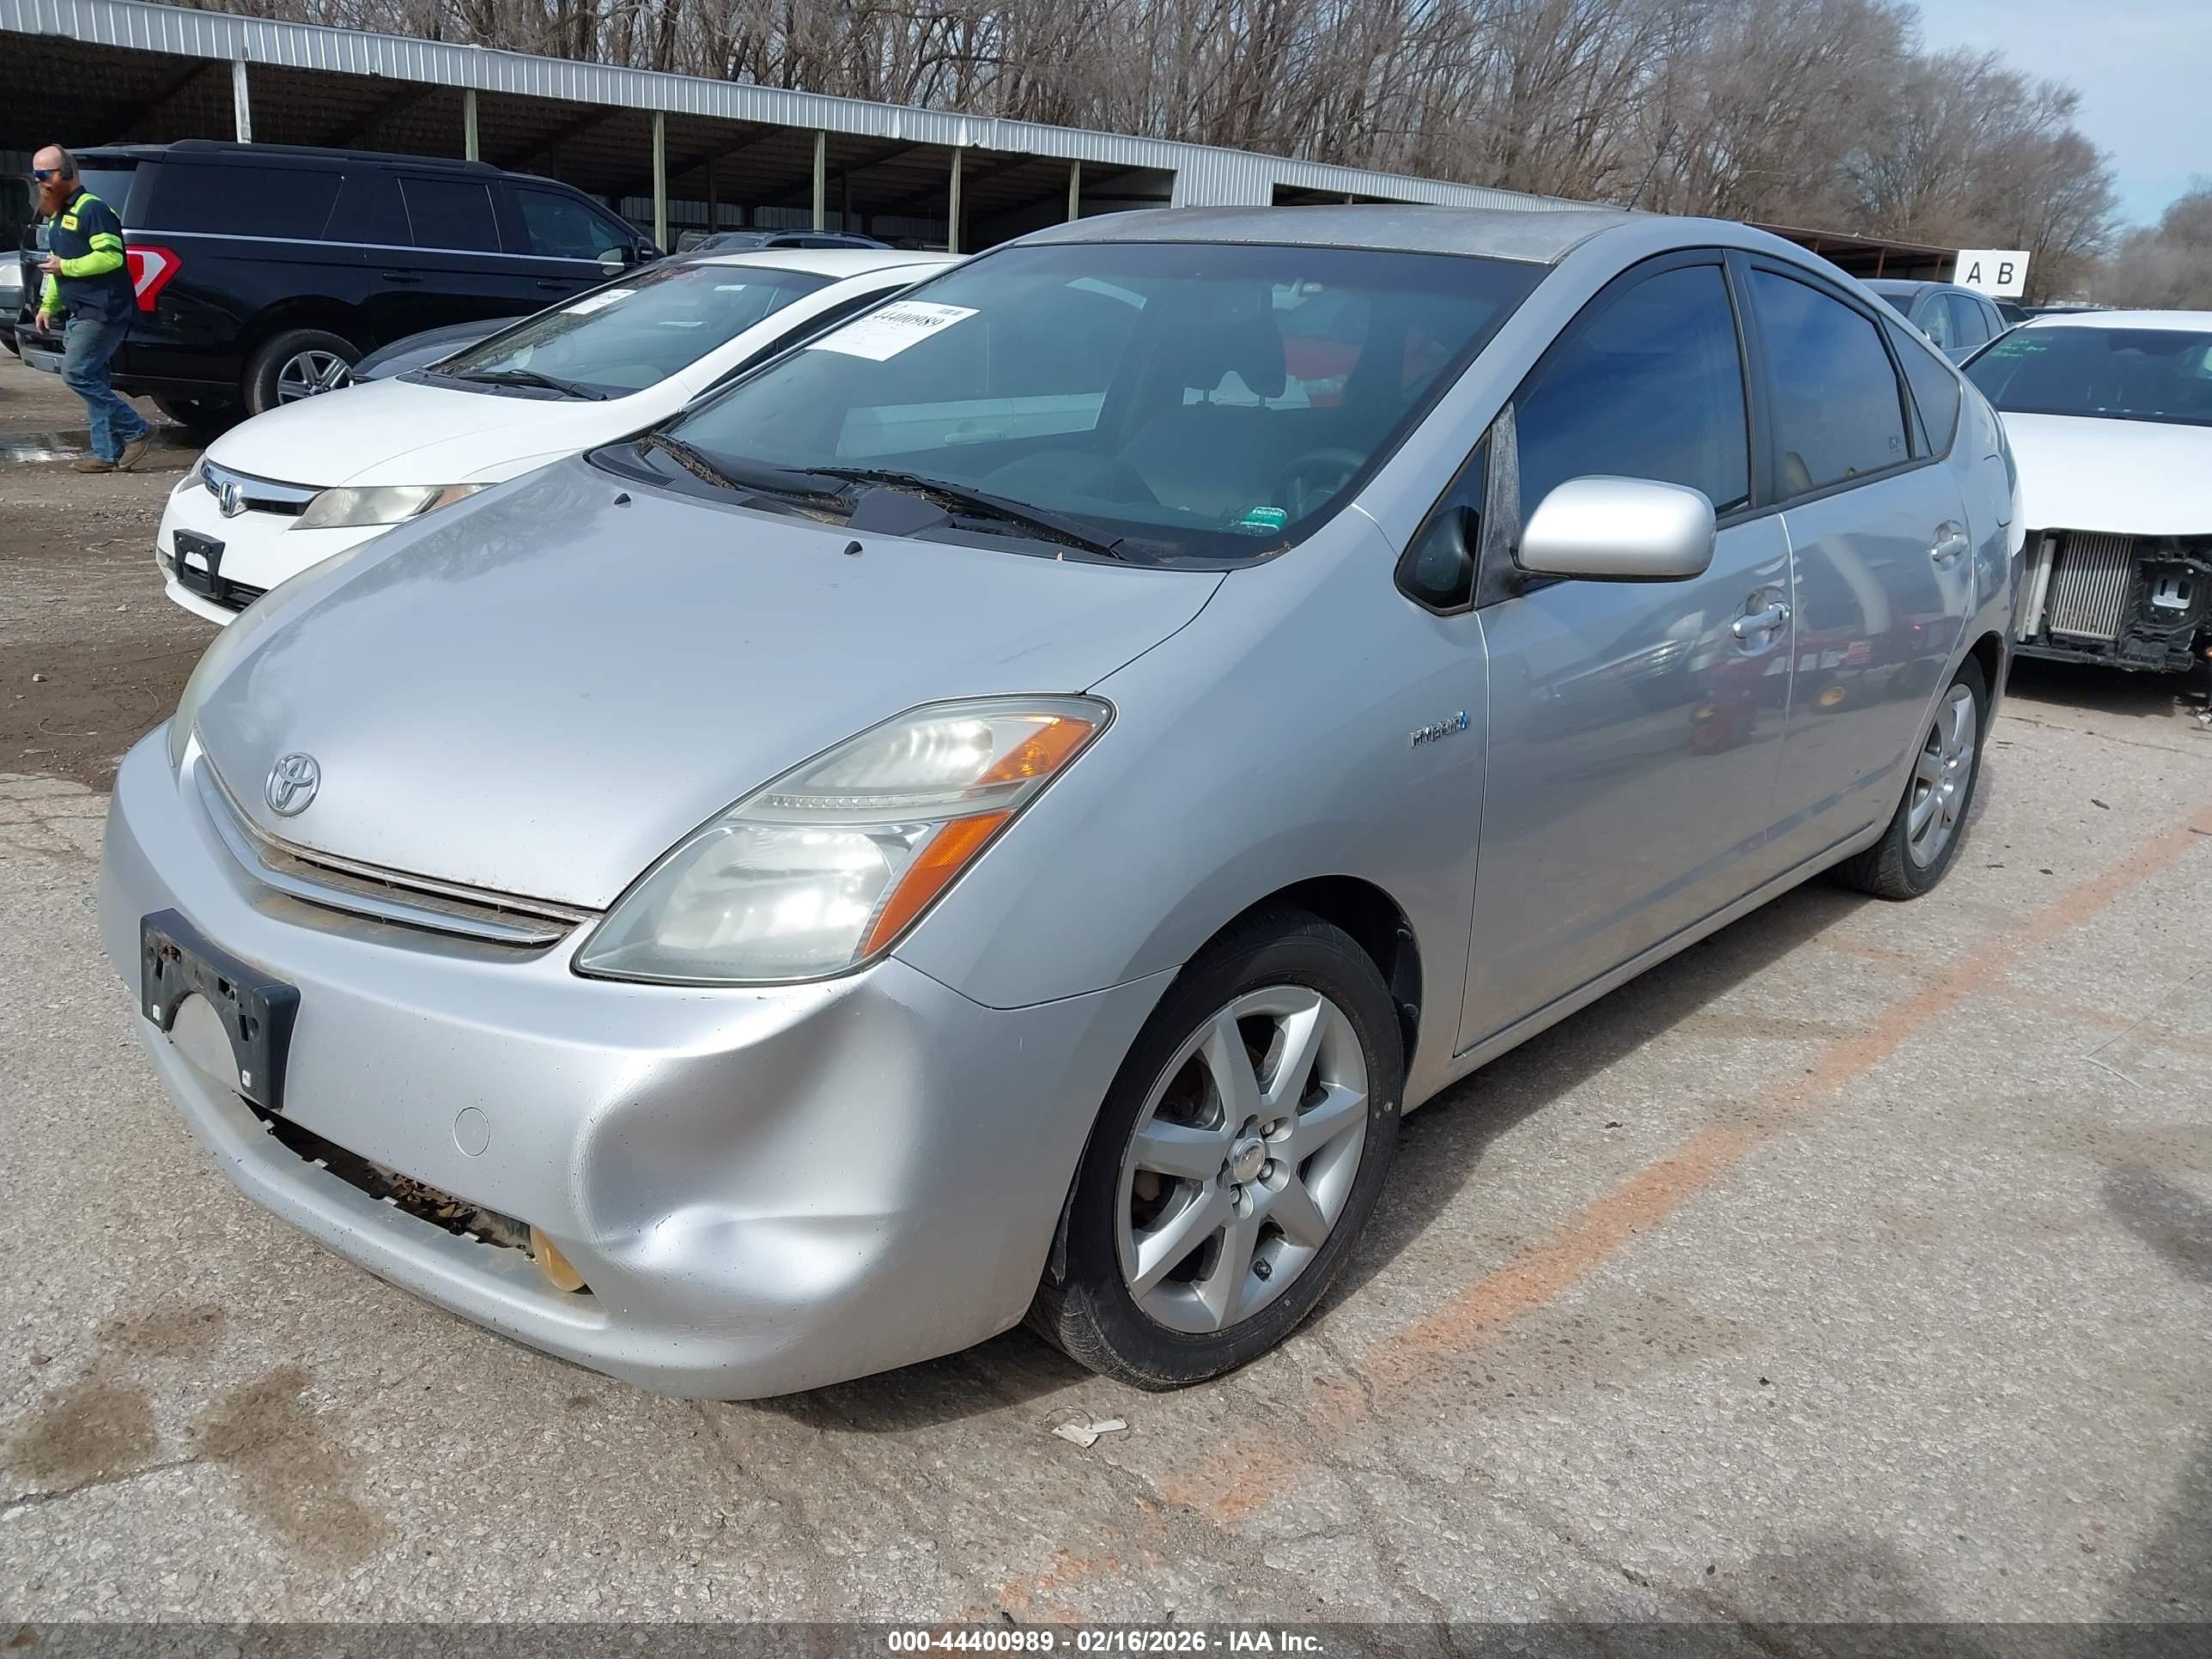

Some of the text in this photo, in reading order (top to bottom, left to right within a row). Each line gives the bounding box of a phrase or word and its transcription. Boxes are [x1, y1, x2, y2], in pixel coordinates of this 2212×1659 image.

[1966, 261, 2014, 285] A B
[872, 310, 945, 328] 44400989
[1408, 714, 1464, 749] HYBRID
